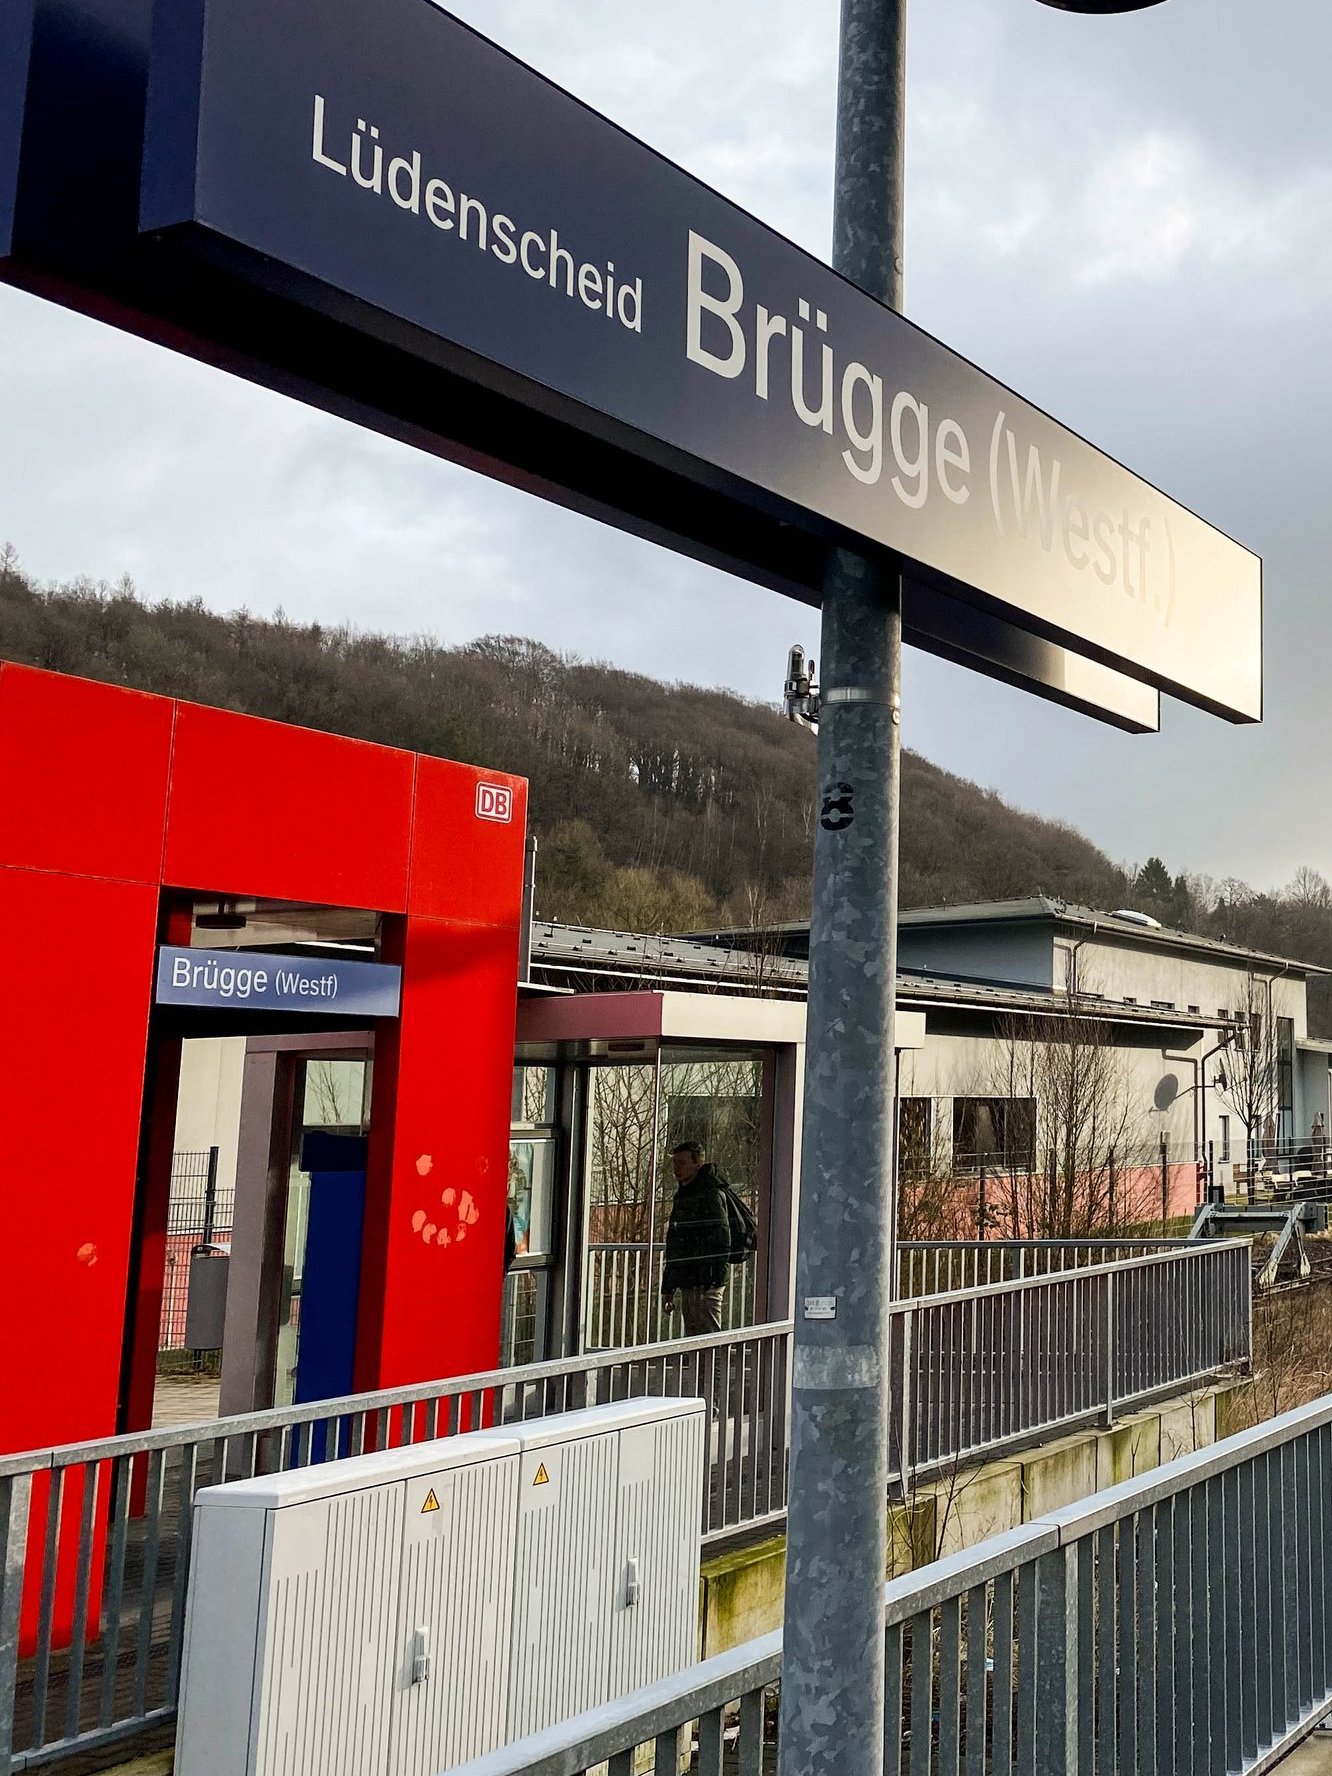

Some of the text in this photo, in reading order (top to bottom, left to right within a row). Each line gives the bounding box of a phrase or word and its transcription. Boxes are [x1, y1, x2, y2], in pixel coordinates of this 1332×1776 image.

[312, 95, 1176, 627] Lüdenscheid Brügge (Westf.)
[481, 789, 507, 815] DB
[172, 957, 338, 999] Brügge (Westf)
